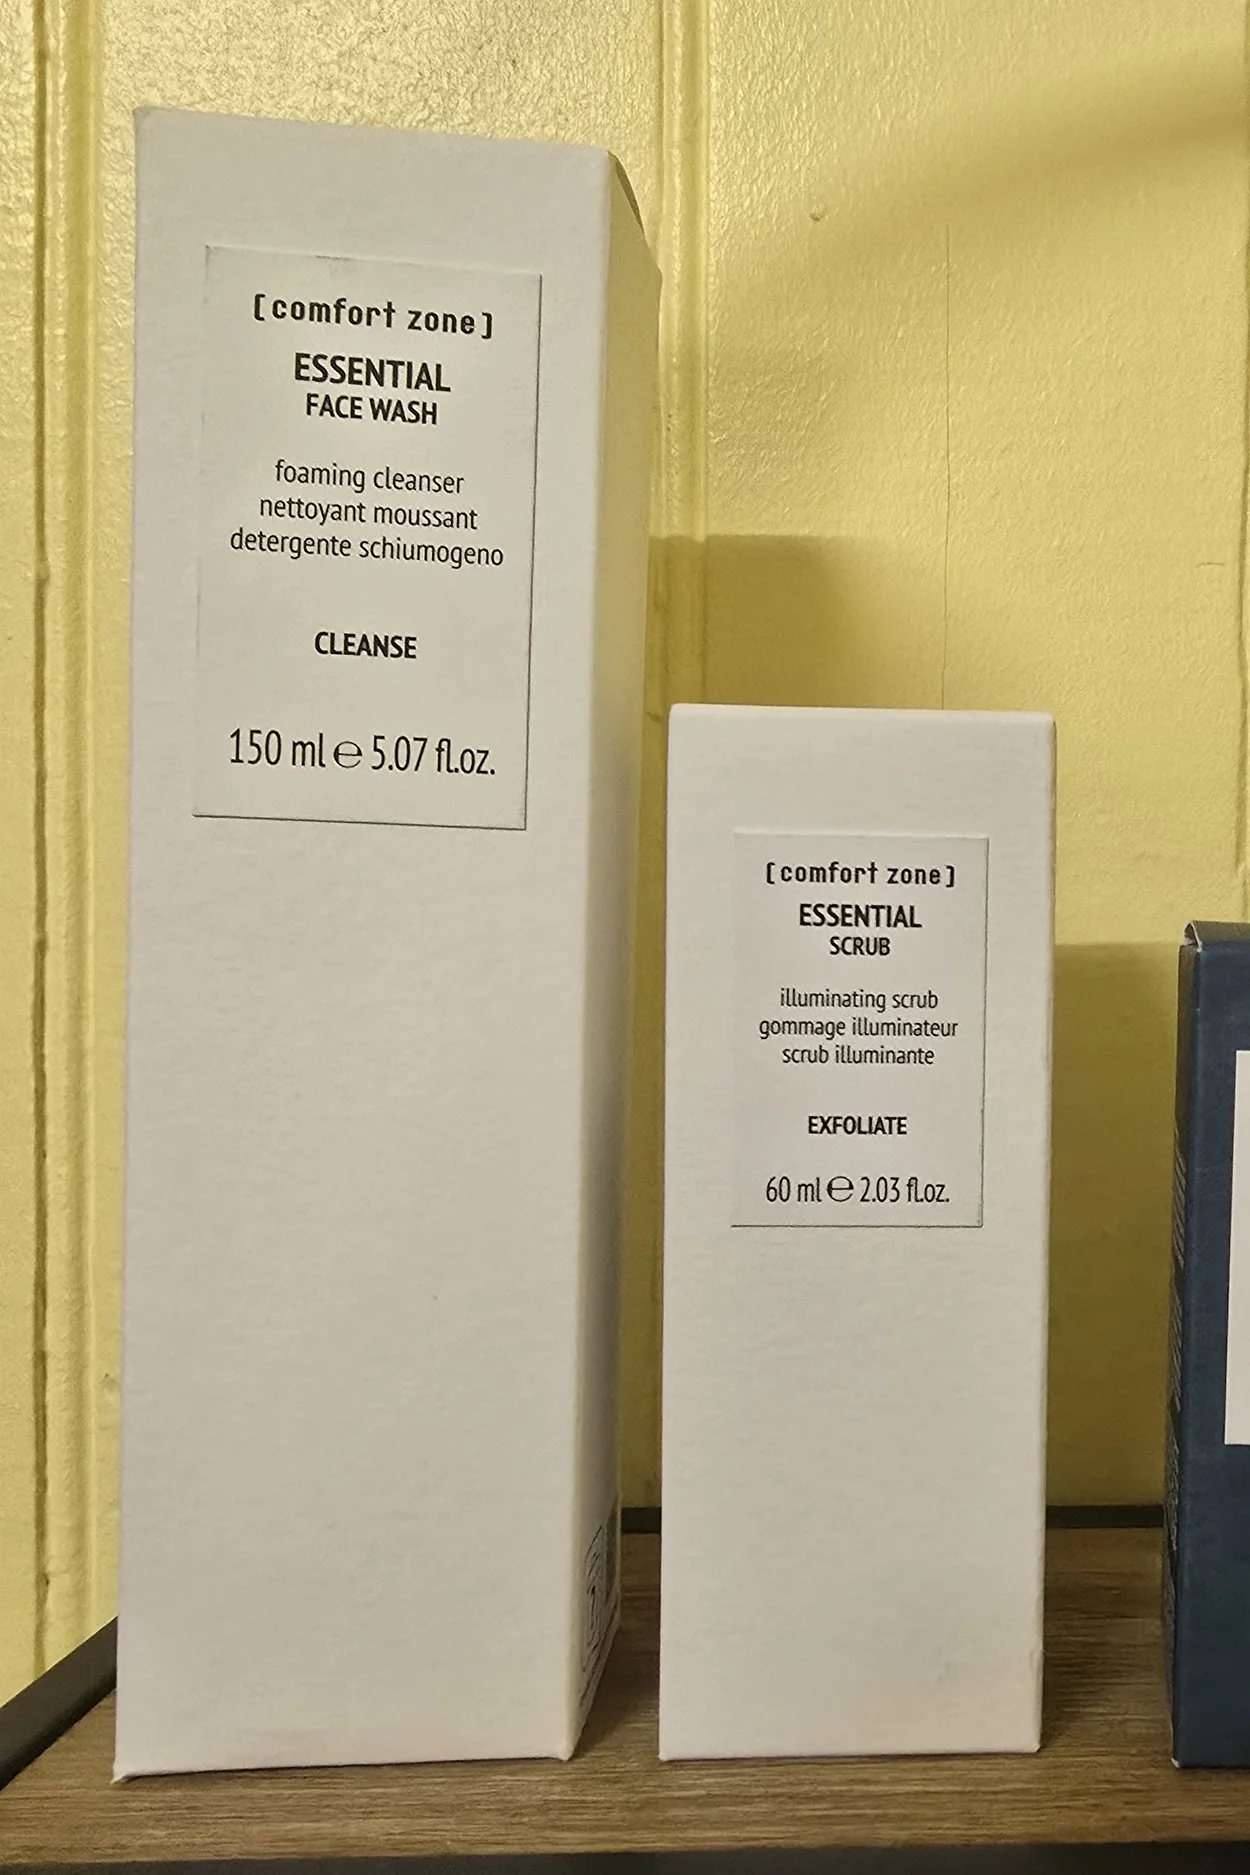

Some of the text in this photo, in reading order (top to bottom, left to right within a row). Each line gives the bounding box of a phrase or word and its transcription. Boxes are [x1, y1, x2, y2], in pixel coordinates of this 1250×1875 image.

[295, 352, 451, 392] ESSENTIAL
[306, 393, 437, 425] FACE WASH
[275, 459, 464, 493] foaming cleanser
[260, 498, 478, 530] nettoyant moussant
[231, 527, 503, 569] detergente schiumogeno
[315, 631, 417, 659] CLEANSE
[230, 728, 281, 765] 150
[292, 733, 326, 768] ml
[371, 735, 428, 771] 5.07
[435, 738, 495, 775] fl.oz.
[800, 903, 922, 928] ESSENTIAL
[830, 936, 890, 956] SCRUB
[781, 988, 938, 1013] illuminating scrub
[759, 1017, 958, 1040] gommage illuminateur
[782, 1044, 934, 1065] scrub illuminante
[808, 1116, 907, 1135] EXFOLIATE
[766, 1176, 791, 1202] 60
[797, 1177, 822, 1202] ml
[860, 1176, 900, 1203] 2.03
[906, 1177, 949, 1203] fl.oz.
